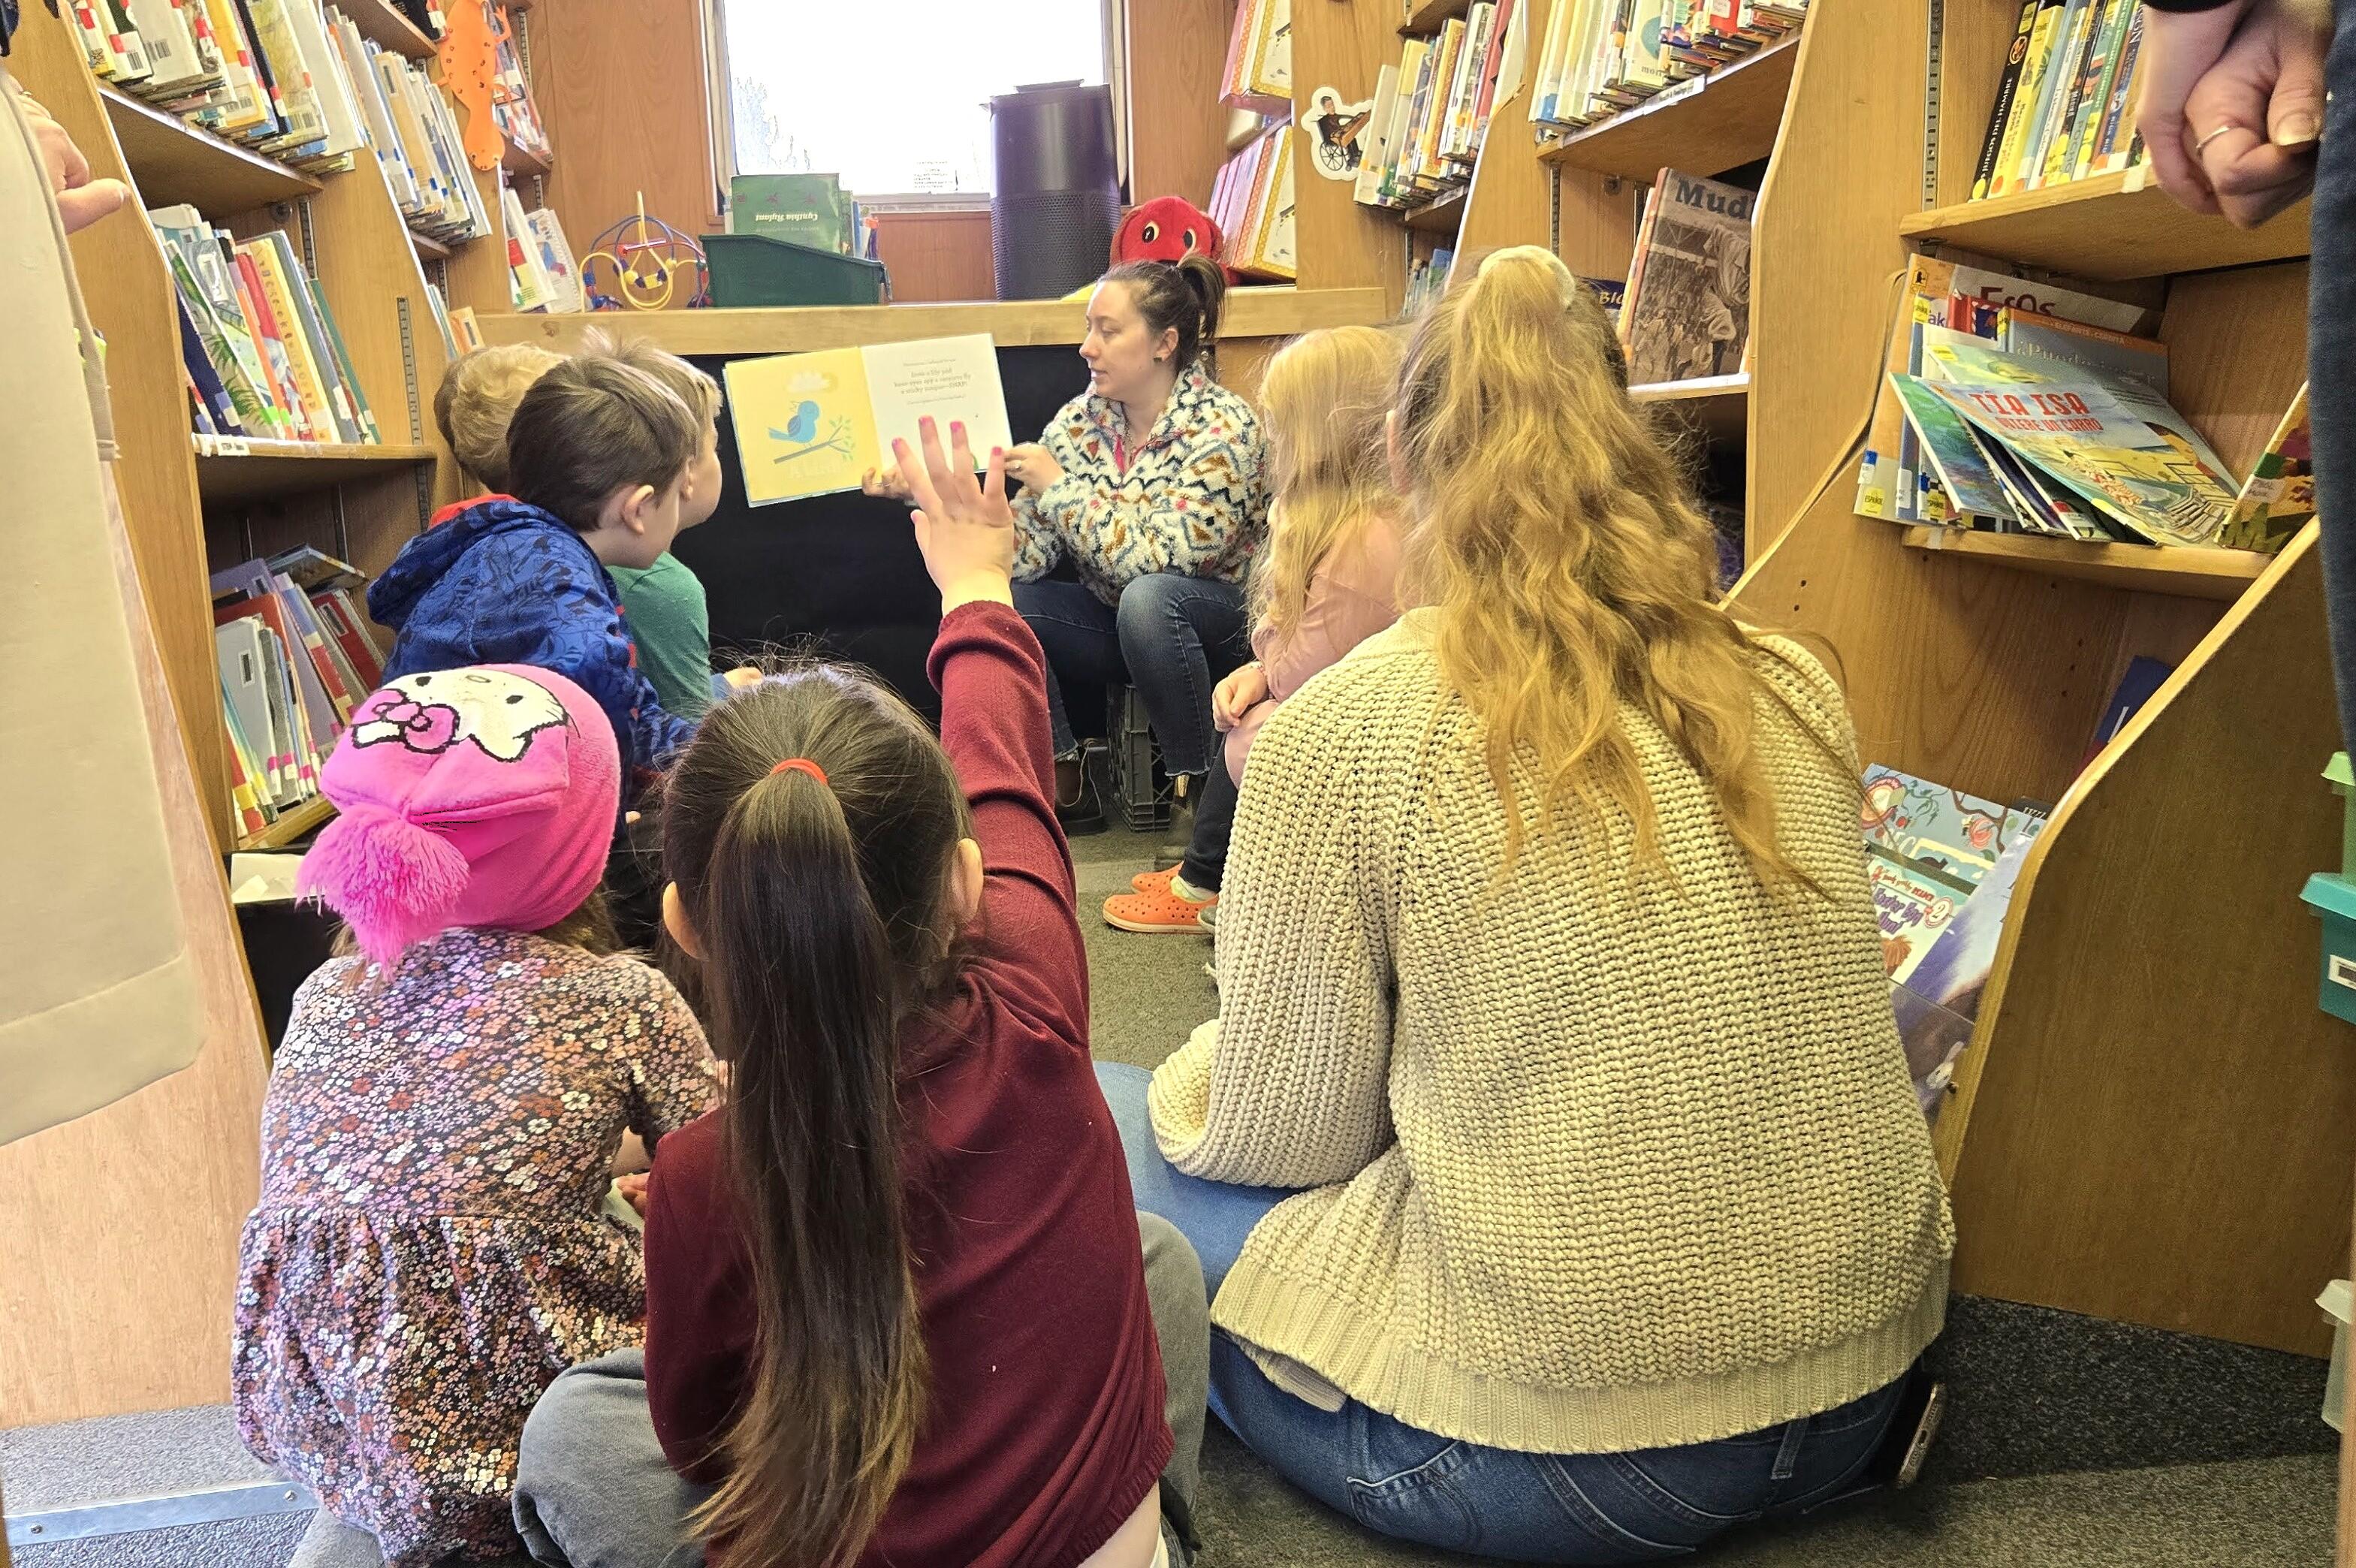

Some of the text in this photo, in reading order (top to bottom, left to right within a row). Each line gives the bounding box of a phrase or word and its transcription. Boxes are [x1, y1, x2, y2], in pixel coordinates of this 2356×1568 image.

[1982, 137, 1996, 172] JUEGOS
[1992, 117, 2002, 137] DEL
[1998, 77, 2014, 116] HAMBRE
[1675, 178, 1756, 219] Mud
[756, 213, 819, 223] Cynthia Rylant
[1928, 312, 1946, 328] ak
[1968, 390, 2090, 415] TÍA ISA
[2062, 418, 2104, 432] CARRO
[1932, 904, 1946, 918] 2
